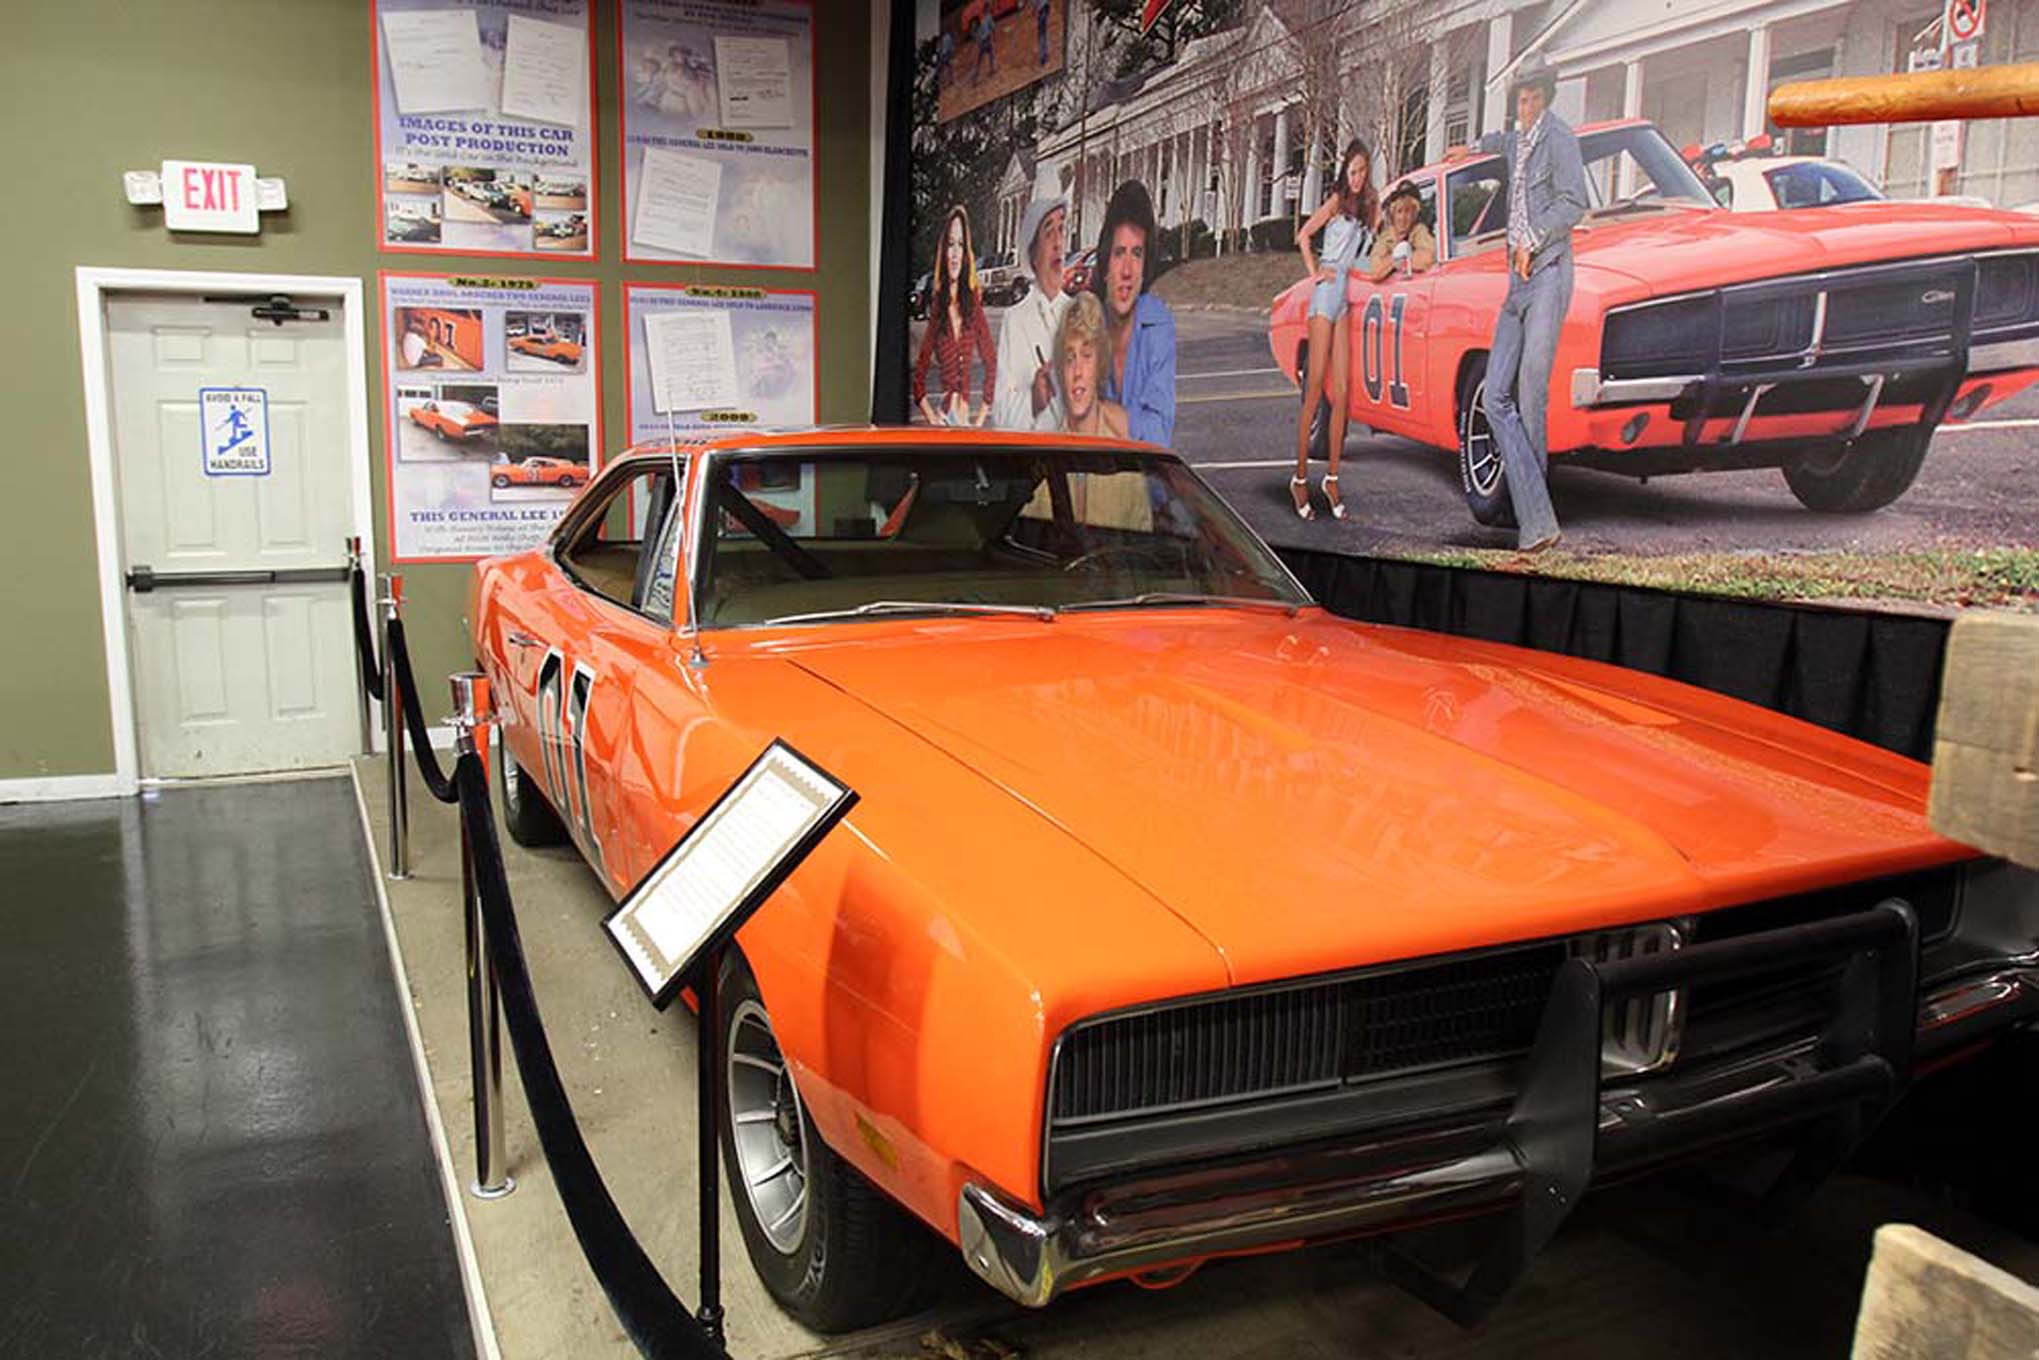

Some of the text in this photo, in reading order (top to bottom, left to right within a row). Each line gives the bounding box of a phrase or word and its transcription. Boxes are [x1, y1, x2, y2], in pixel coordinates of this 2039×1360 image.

[399, 116, 574, 142] IMAGES OF THIS CAR
[406, 132, 569, 156] POST PRODUCTION
[183, 168, 242, 212] EXIT
[1362, 293, 1411, 409] 01
[210, 459, 264, 470] HANDRAILS
[410, 511, 444, 522] THIS
[448, 511, 519, 522] GENERAL
[521, 511, 548, 521] LEE
[538, 645, 612, 880] 01
